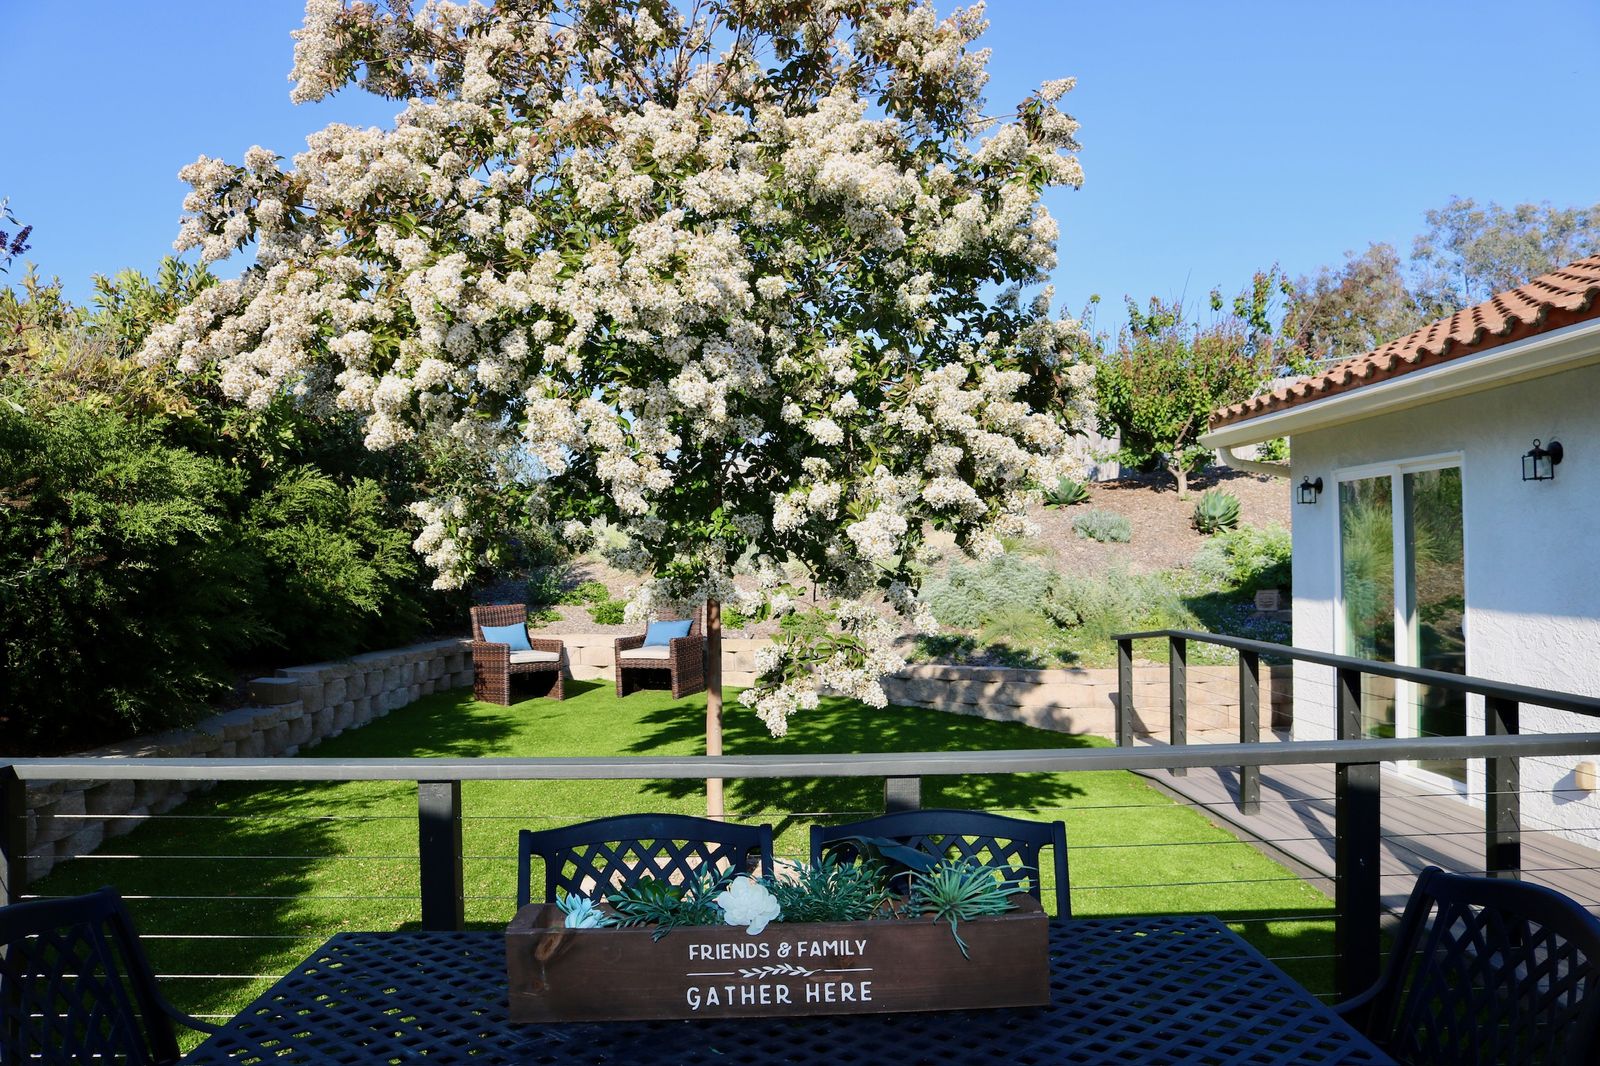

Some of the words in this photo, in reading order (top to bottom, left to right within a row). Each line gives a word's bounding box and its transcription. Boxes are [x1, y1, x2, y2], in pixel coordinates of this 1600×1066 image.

[688, 943, 770, 961] FRIENDS
[776, 941, 792, 958] &
[797, 939, 867, 958] FAMILY
[686, 984, 792, 1011] GATHER
[805, 981, 872, 1003] HERE
